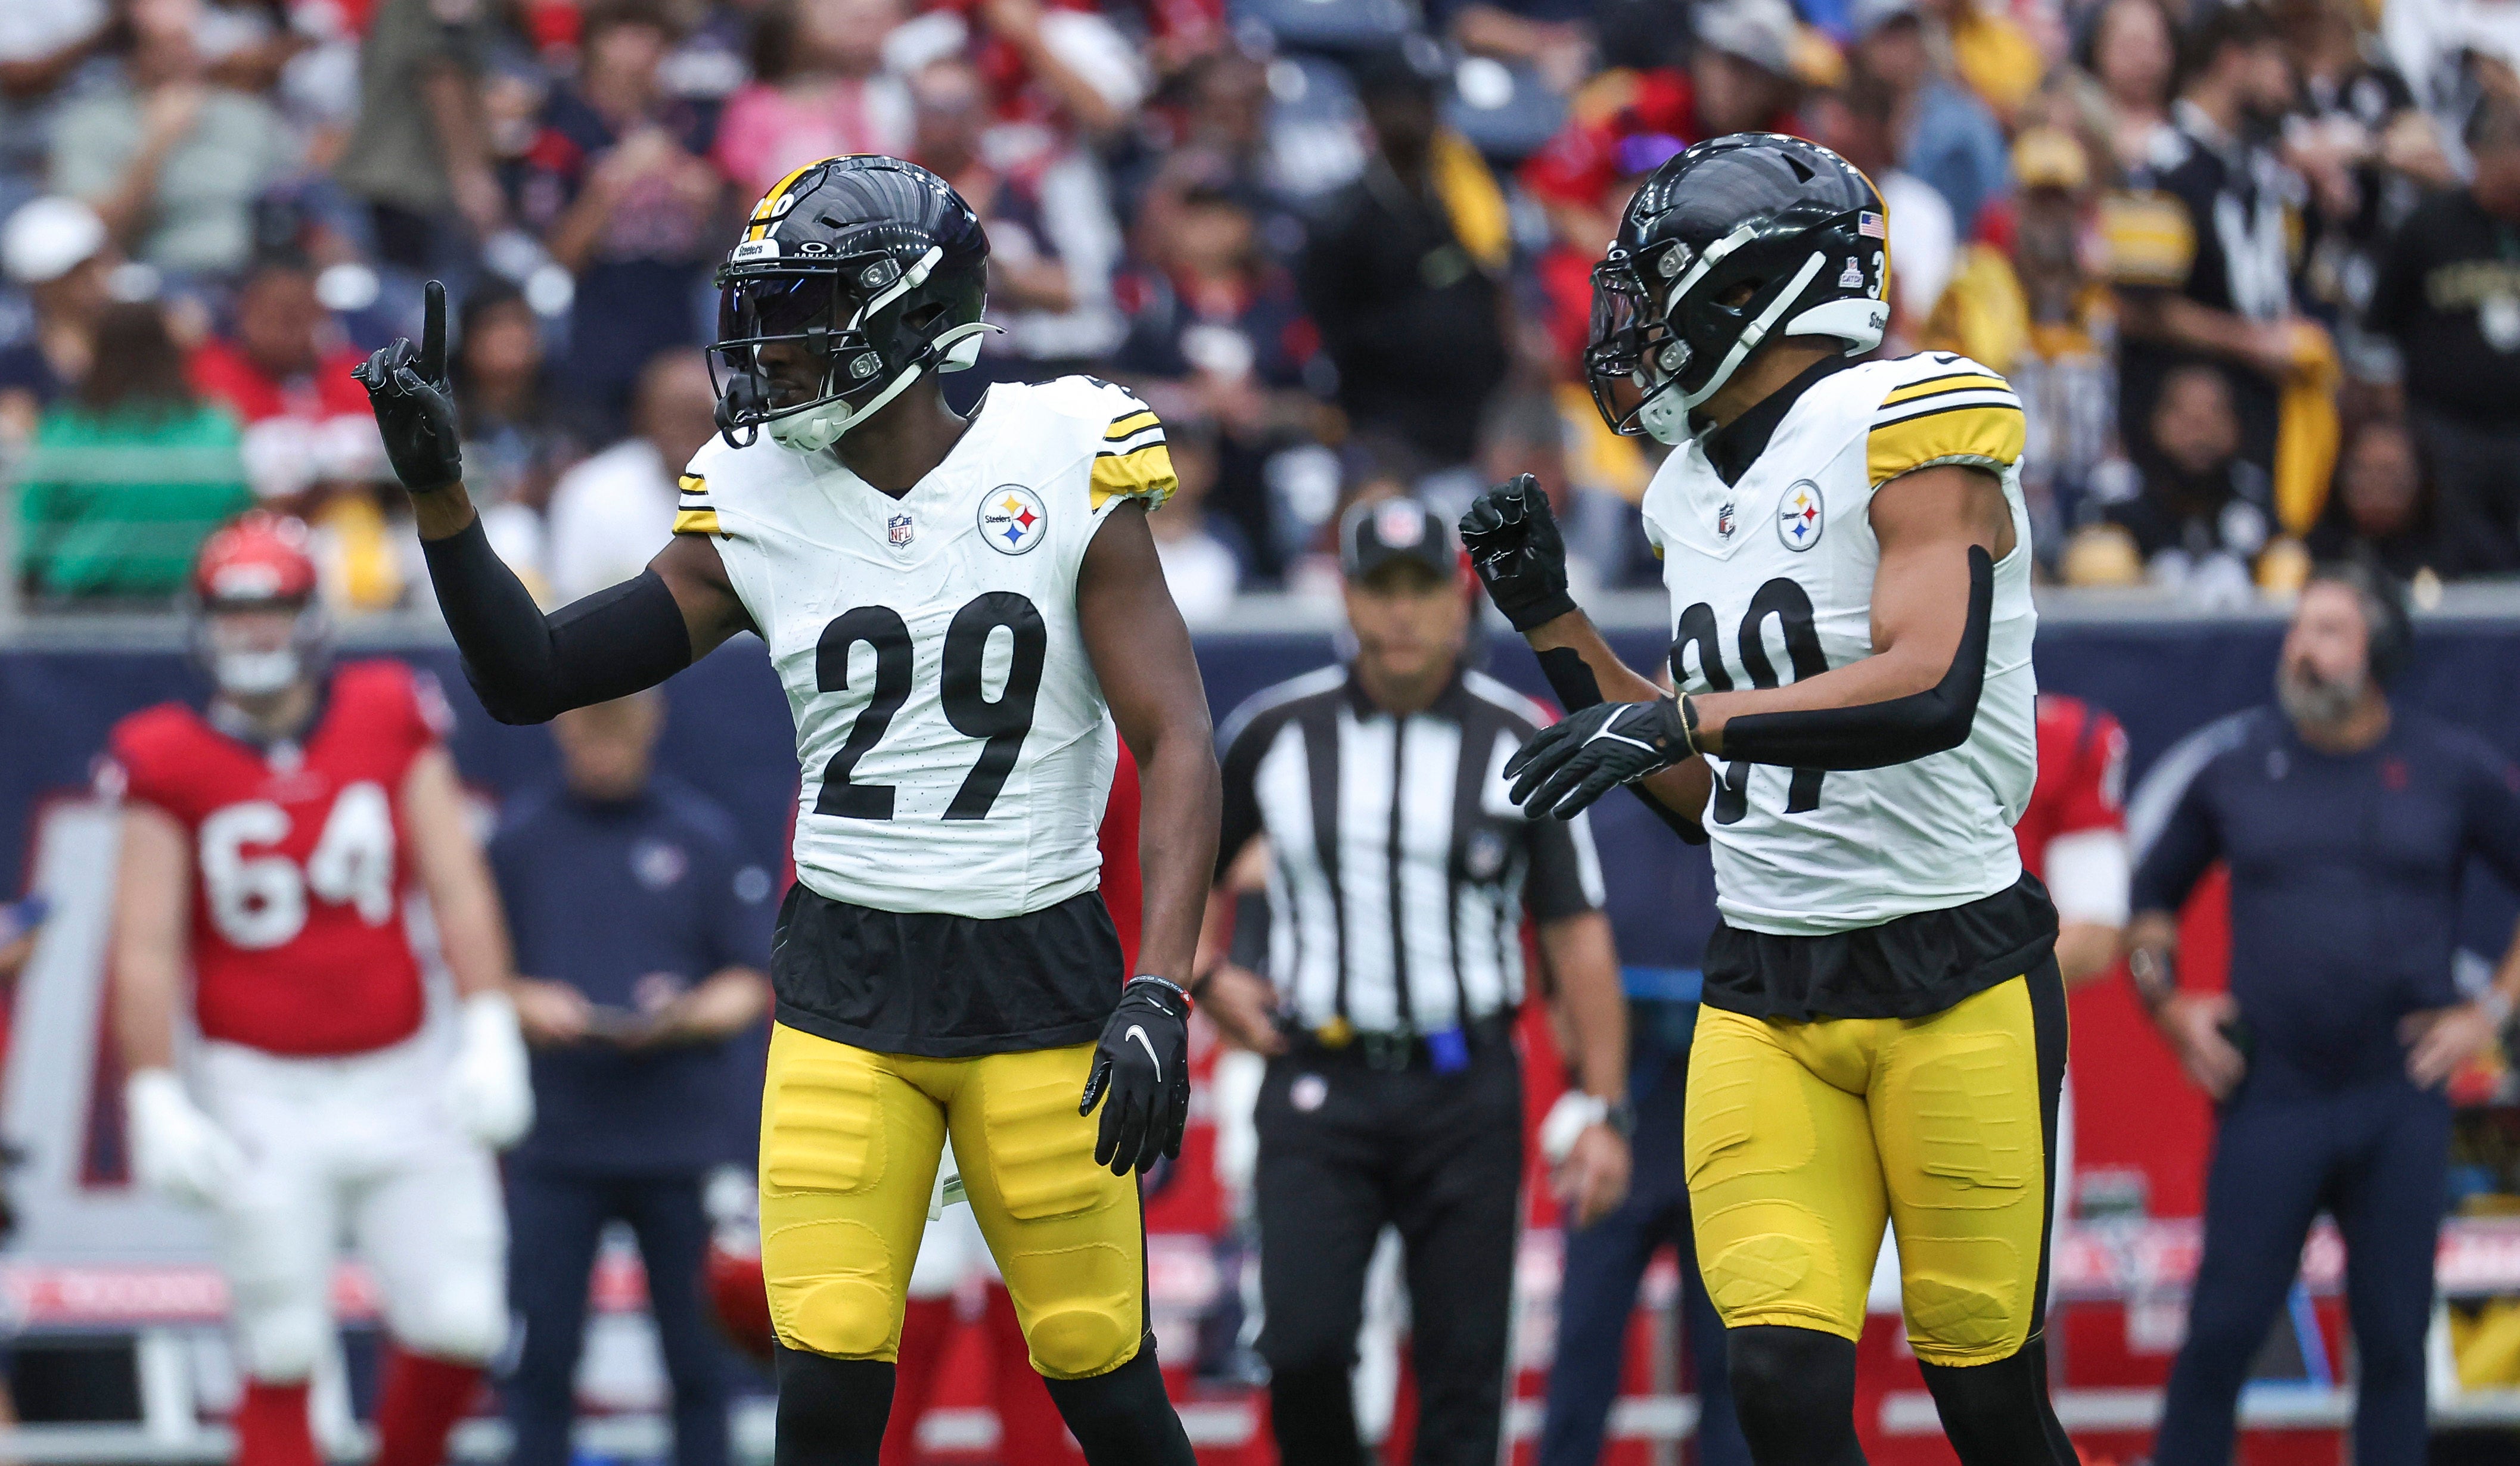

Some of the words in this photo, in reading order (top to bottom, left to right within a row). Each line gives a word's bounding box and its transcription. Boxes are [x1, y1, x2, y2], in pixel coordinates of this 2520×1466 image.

[738, 244, 763, 257] Steelers
[985, 515, 1011, 524] Steelers
[890, 527, 911, 541] NFL
[813, 591, 1048, 820] 29
[198, 781, 396, 950] 64
